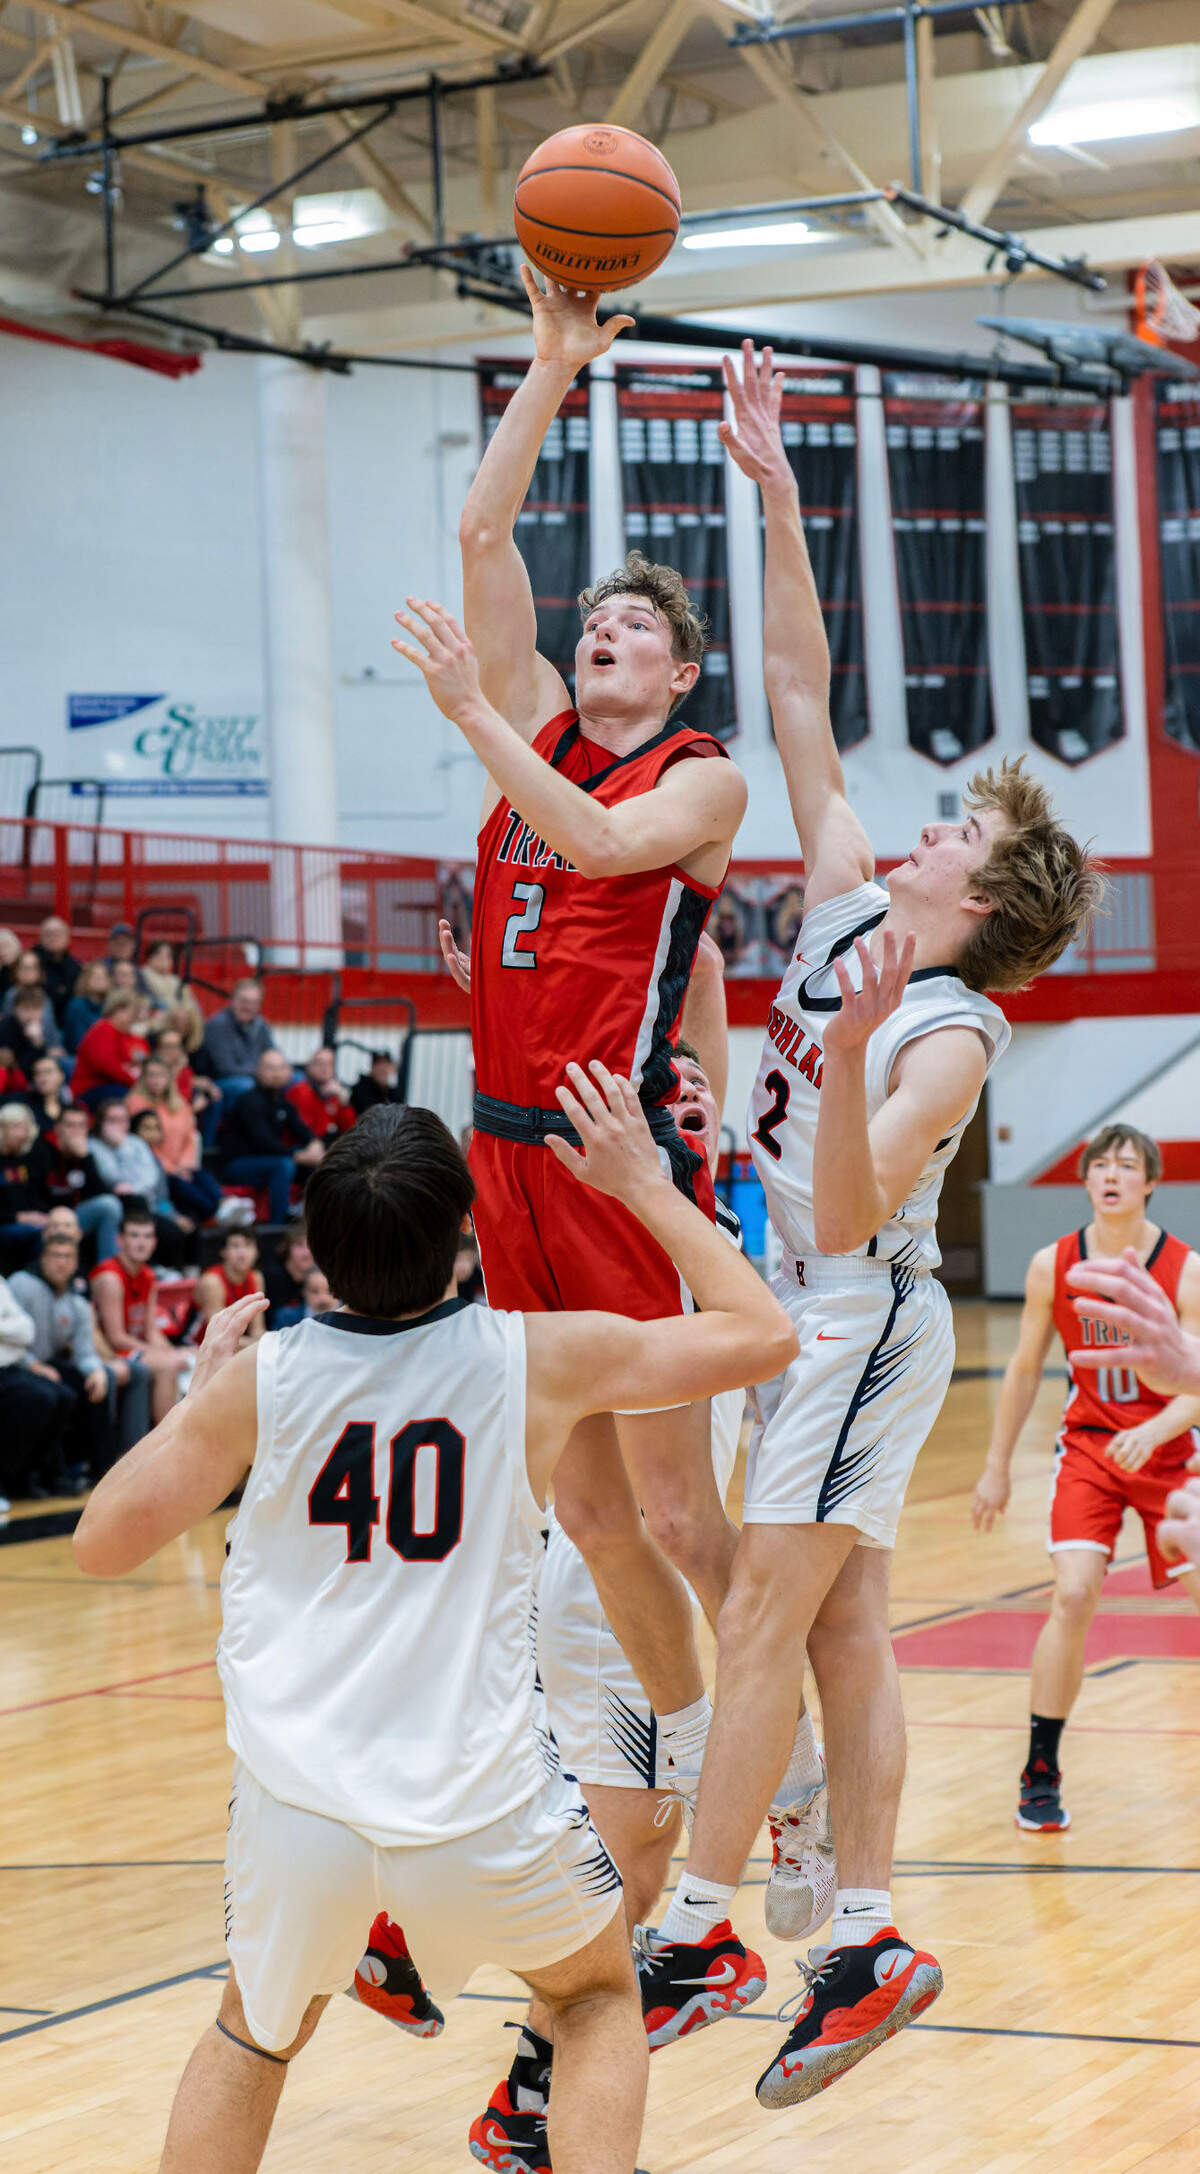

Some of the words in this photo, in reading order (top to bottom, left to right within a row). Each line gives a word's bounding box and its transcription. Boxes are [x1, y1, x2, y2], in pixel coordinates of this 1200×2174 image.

[536, 242, 640, 271] EVOLUTION
[497, 808, 579, 872] TRIA
[501, 880, 546, 969] 2
[768, 1003, 824, 1090] GHLA
[751, 1068, 791, 1161] 2
[1097, 1366, 1140, 1403] 10
[308, 1417, 466, 1564] 40
